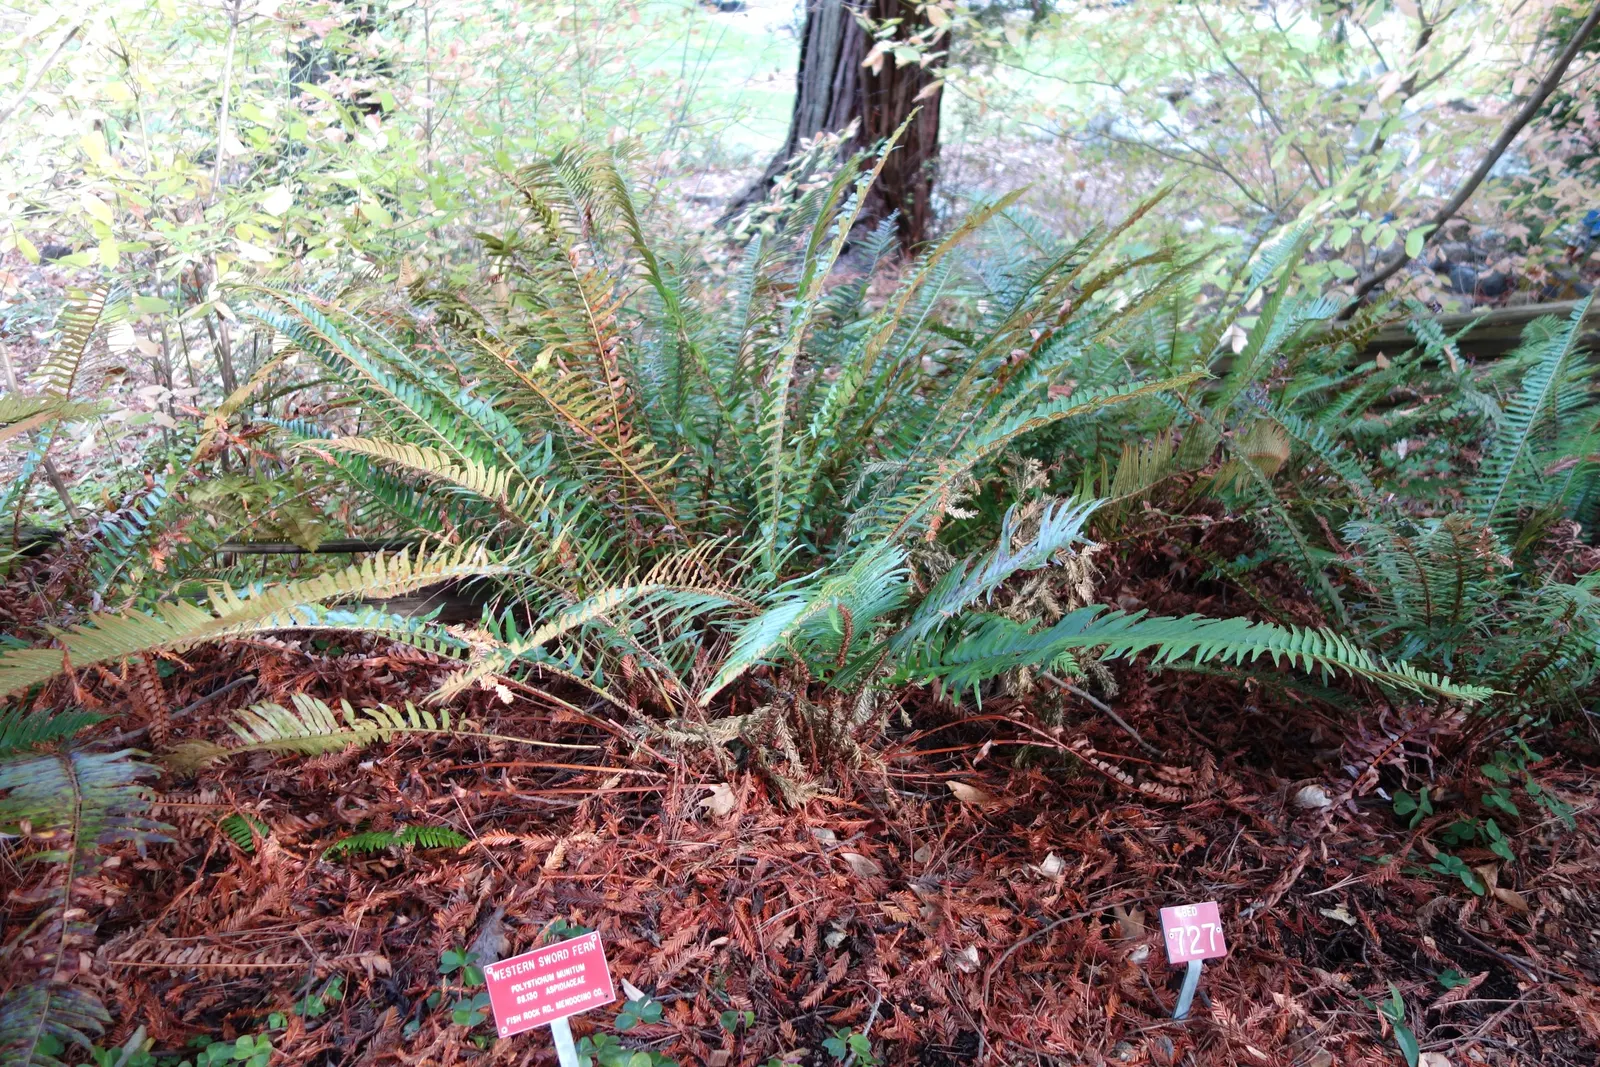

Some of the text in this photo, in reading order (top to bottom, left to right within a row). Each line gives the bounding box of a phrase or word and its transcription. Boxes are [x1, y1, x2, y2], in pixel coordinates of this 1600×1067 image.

[1182, 906, 1197, 917] BED
[1170, 923, 1216, 956] 727
[492, 941, 596, 982] WESTERN SWORD FERN
[511, 963, 585, 993] POLYSTICHUM MUNITUM
[546, 976, 586, 995] ASPIDIACEAE
[506, 1015, 522, 1026] FISH
[523, 1008, 540, 1020] ROCK
[556, 991, 592, 1009] MENDOCINO
